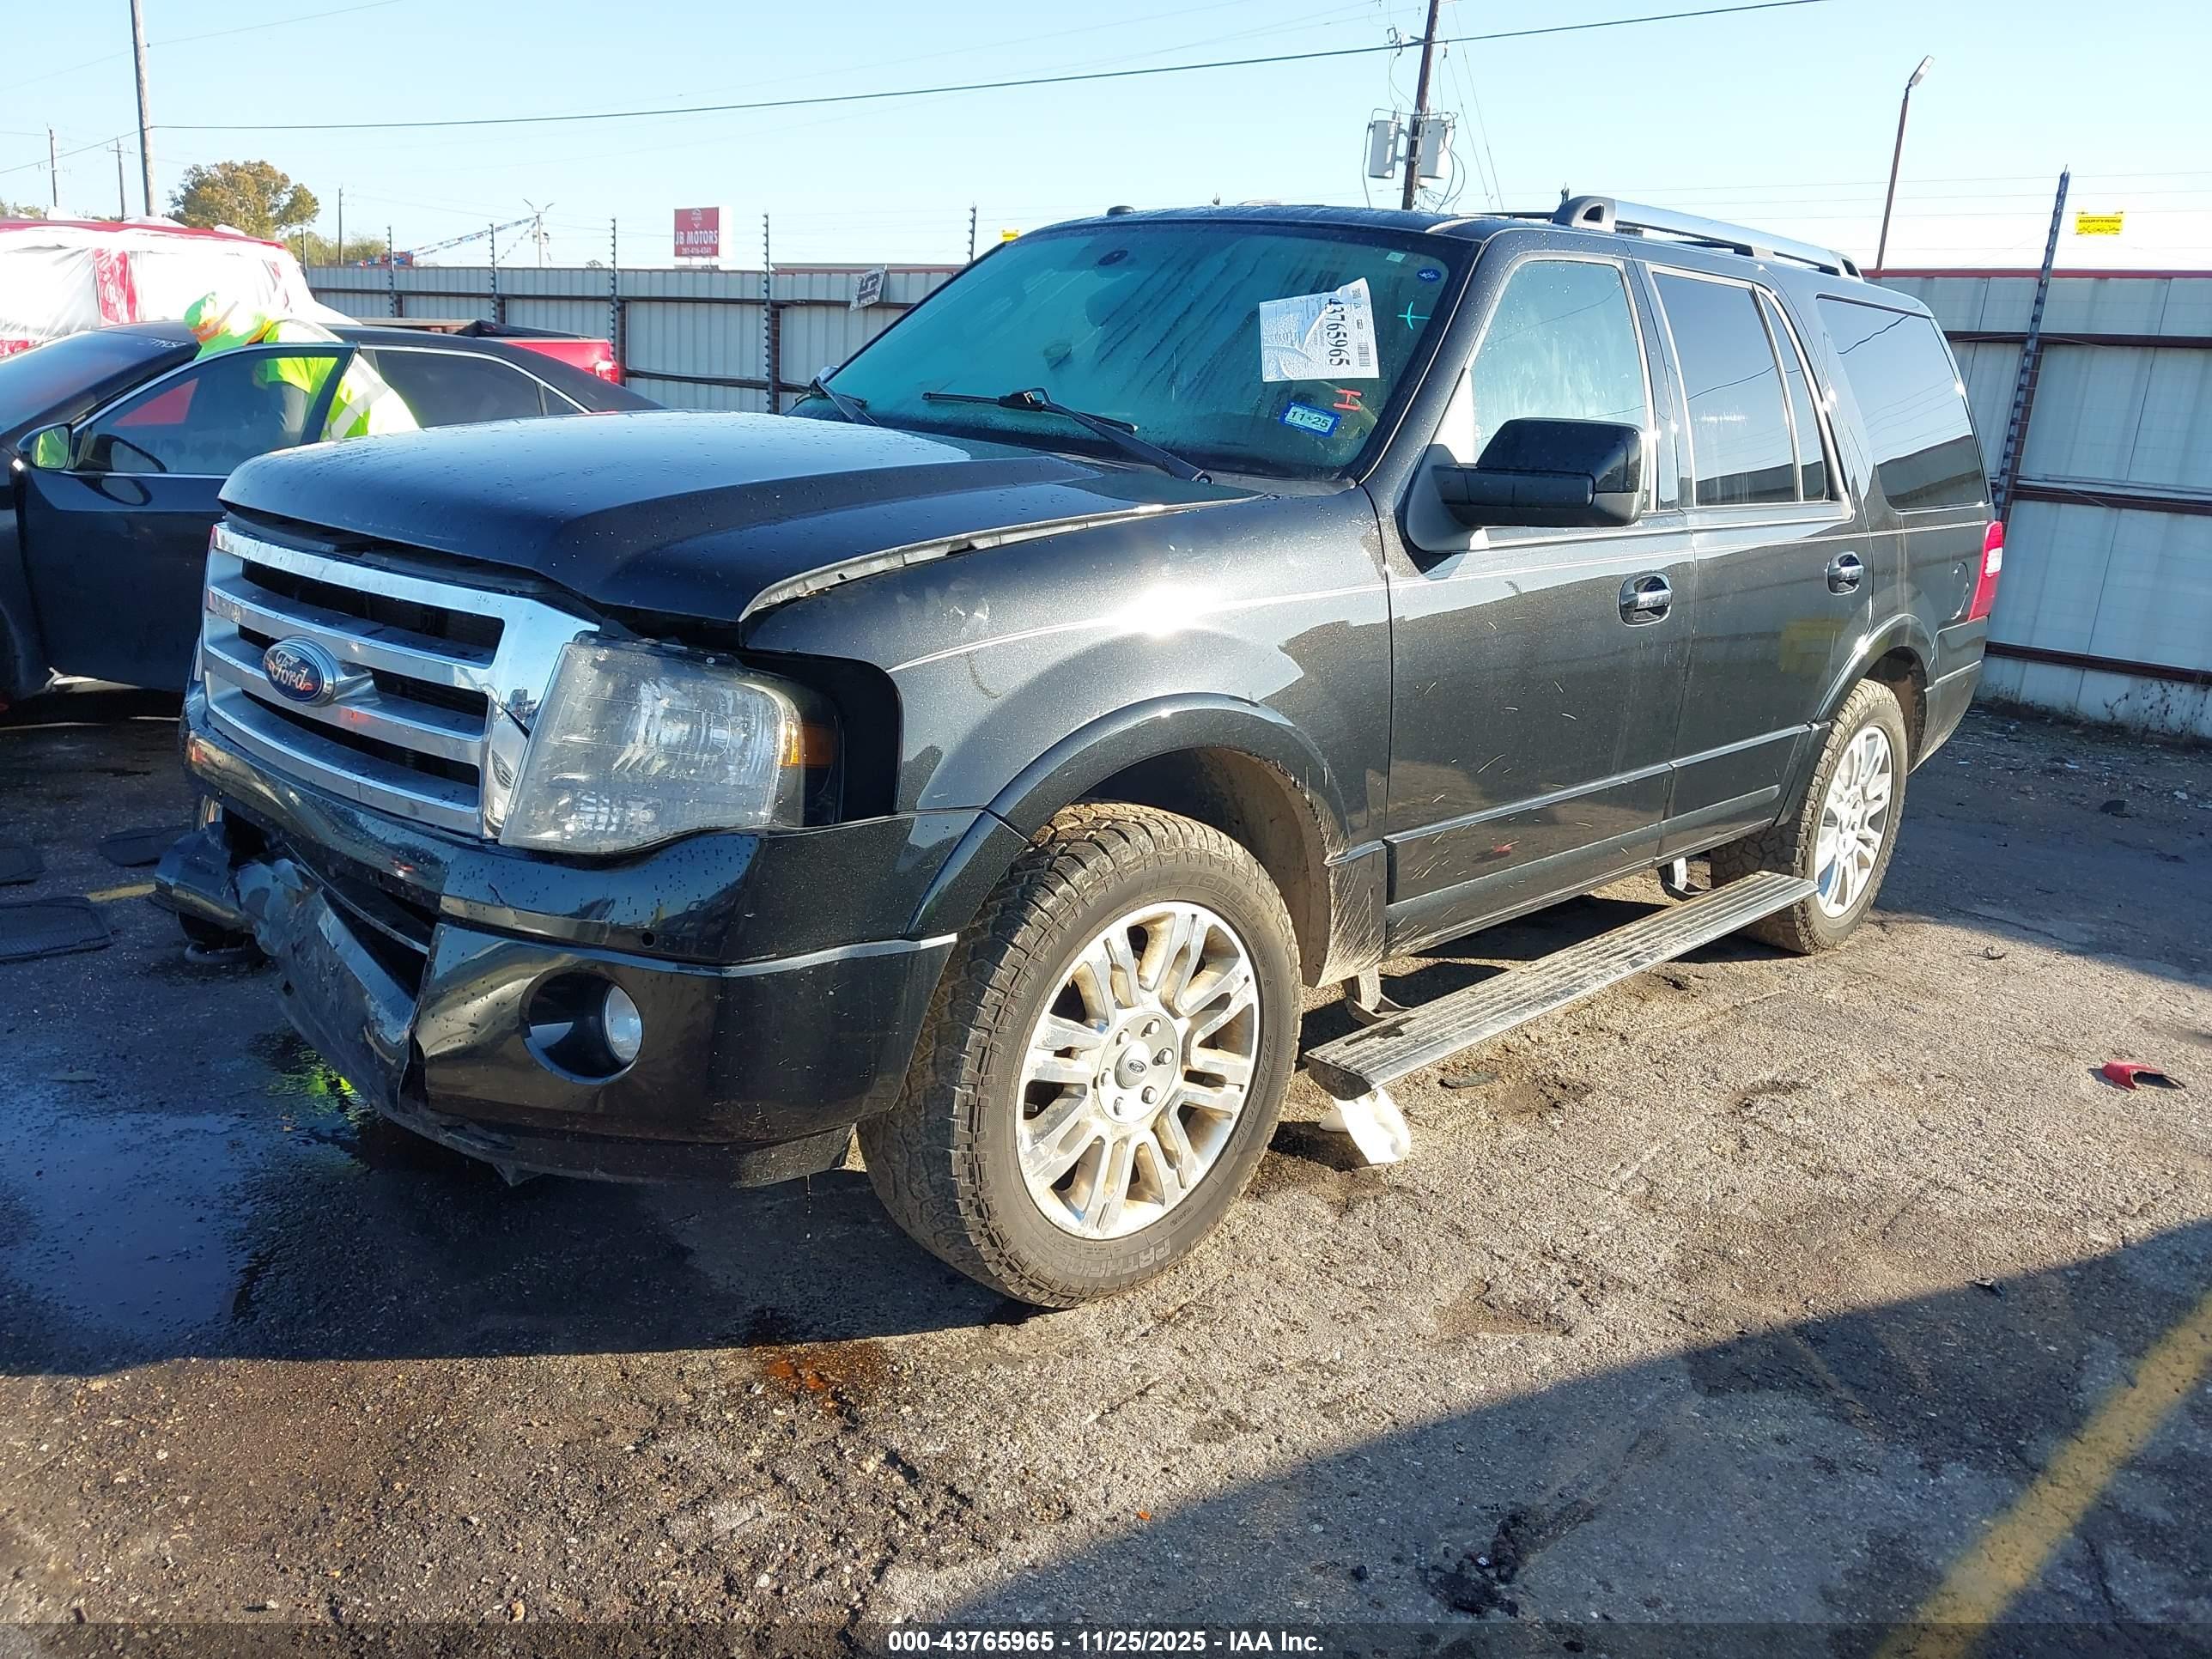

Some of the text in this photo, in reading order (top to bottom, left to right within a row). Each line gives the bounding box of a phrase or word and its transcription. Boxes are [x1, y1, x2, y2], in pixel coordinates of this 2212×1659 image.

[675, 229, 718, 246] JB MOTORS
[1324, 297, 1351, 367] 43765965
[267, 650, 310, 691] Ford
